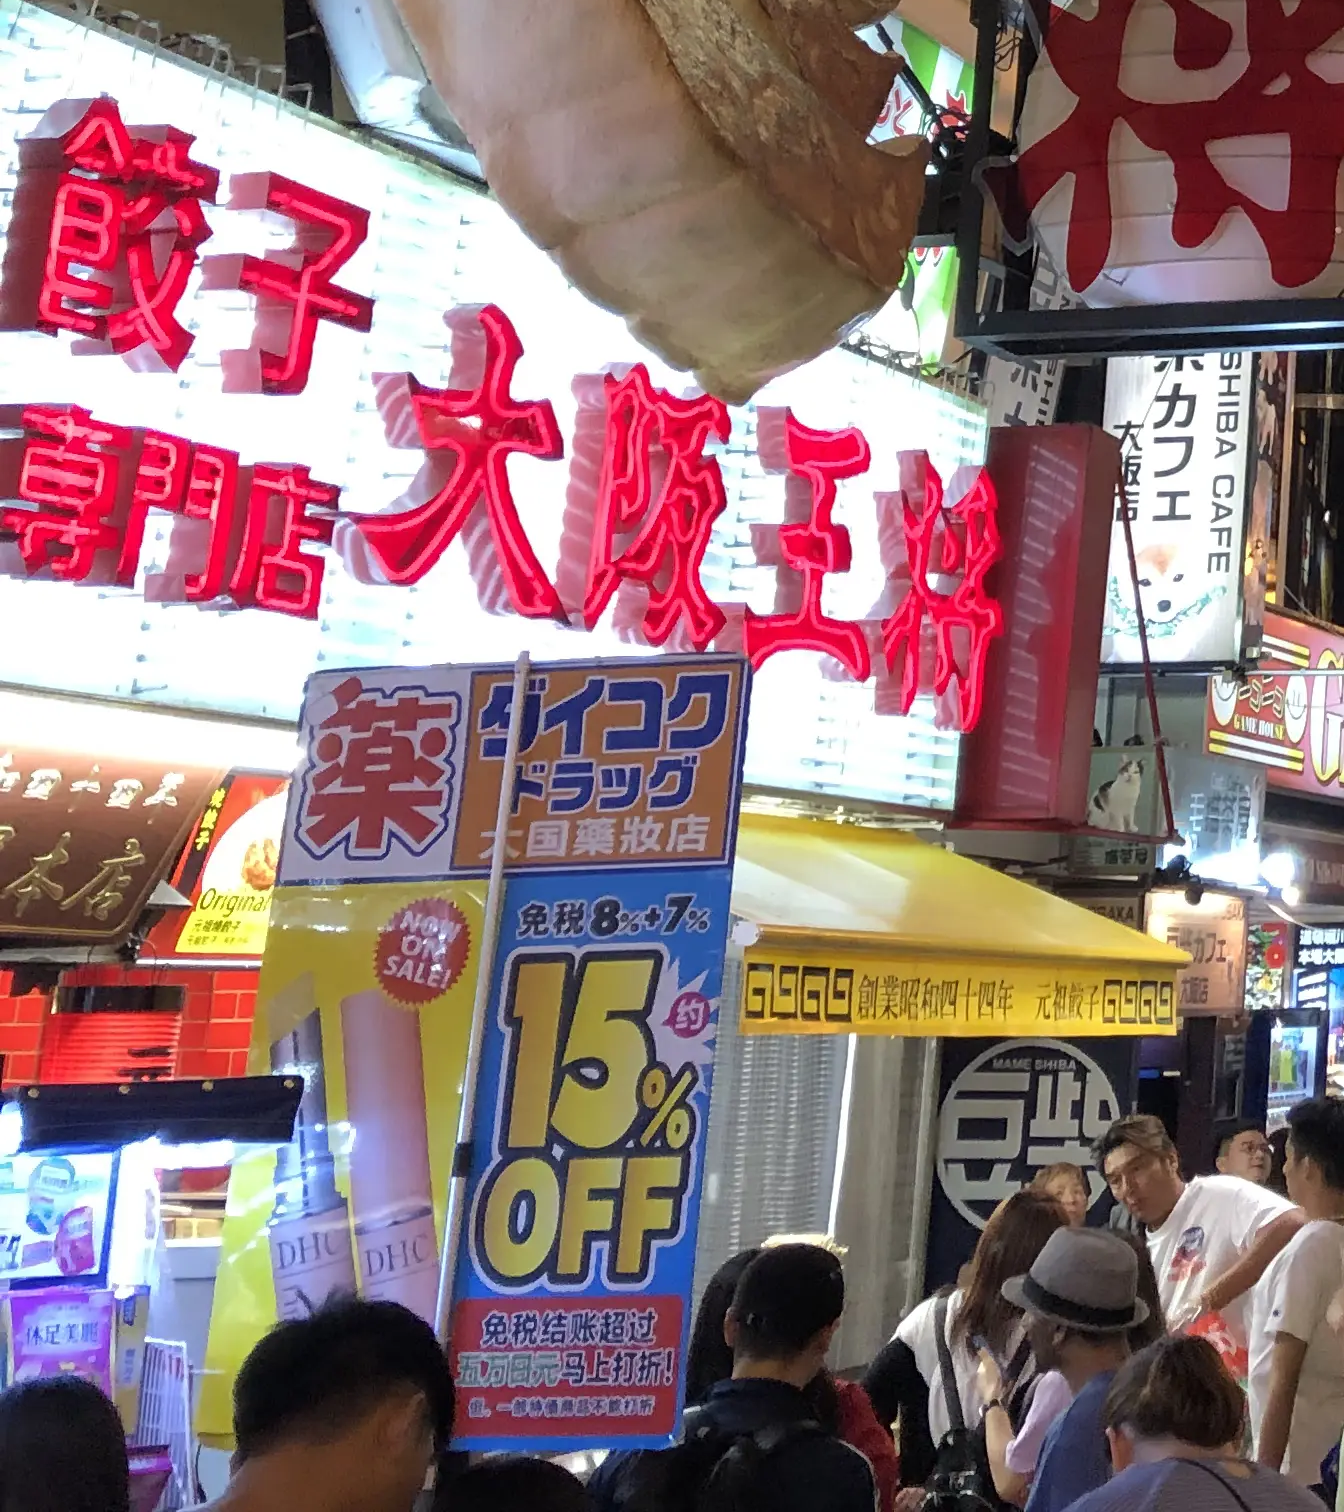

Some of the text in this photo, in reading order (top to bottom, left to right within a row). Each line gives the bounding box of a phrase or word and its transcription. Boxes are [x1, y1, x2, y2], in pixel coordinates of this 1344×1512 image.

[25, 93, 374, 393] 餃子
[5, 402, 340, 619] 専門店
[352, 303, 1001, 731] 大阪王将
[1208, 474, 1234, 574] CAFE
[480, 672, 731, 758] ダイコク
[306, 676, 453, 851] 薬
[511, 754, 699, 814] ドラッグ
[199, 888, 271, 918] Original
[401, 910, 462, 943] NOW
[383, 957, 452, 989] SALE!
[401, 936, 446, 962] ON
[673, 996, 707, 1033] 约
[857, 973, 1015, 1022] 創業昭和四十四年
[1034, 981, 1100, 1021] 元祖餃子
[505, 951, 698, 1154] 15%
[476, 1152, 687, 1286] OFF
[275, 1227, 346, 1270] DHC
[363, 1233, 432, 1277] DHC
[481, 1309, 657, 1346] 免税结账超过
